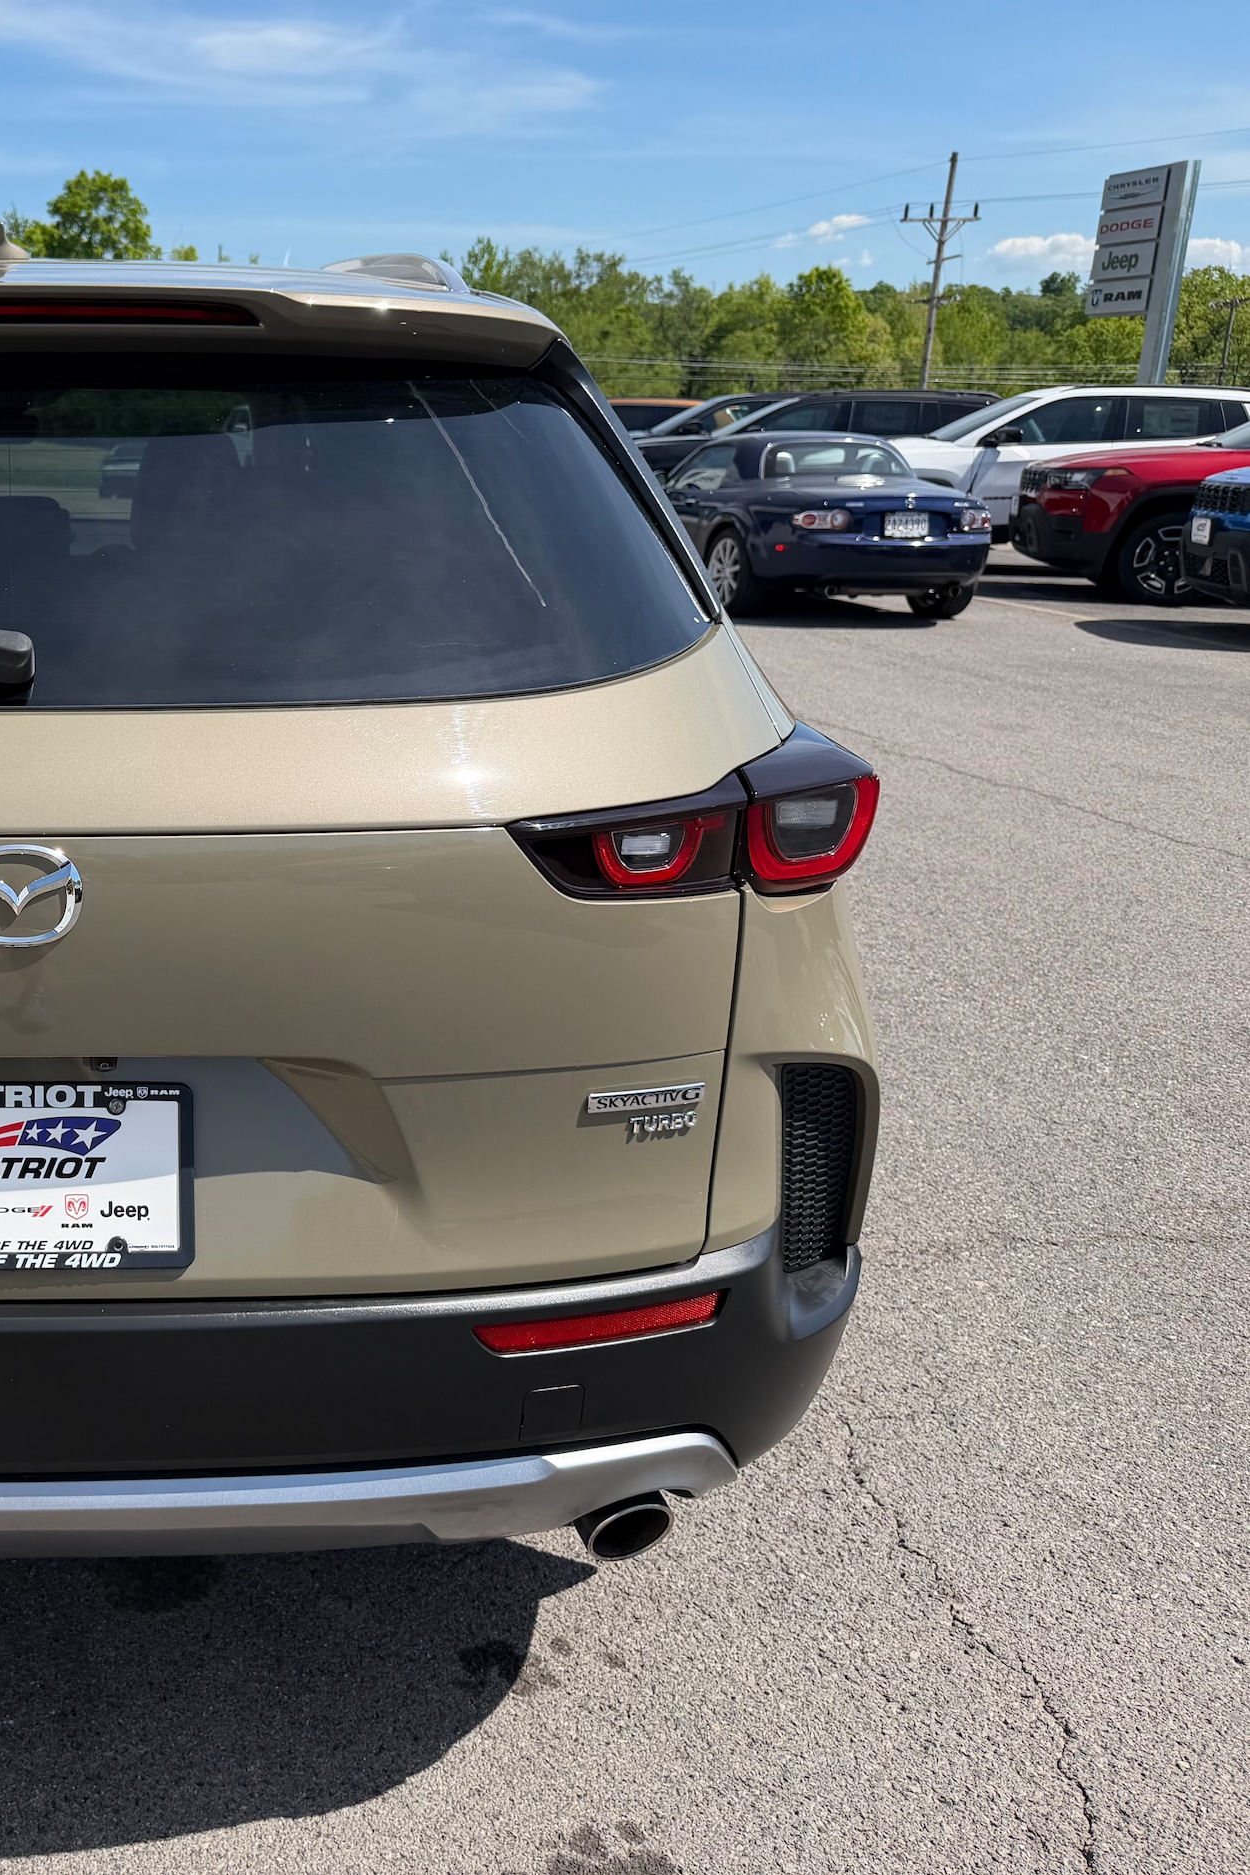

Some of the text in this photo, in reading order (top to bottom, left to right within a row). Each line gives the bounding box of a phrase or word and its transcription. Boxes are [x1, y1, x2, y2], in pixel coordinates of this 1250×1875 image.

[1108, 176, 1159, 191] CHRYSLER
[1099, 217, 1154, 234] DODGE
[1101, 251, 1139, 273] Jeep
[1103, 290, 1142, 303] RAM
[104, 1086, 134, 1099] Jeep
[630, 1110, 698, 1134] TURBO
[100, 1201, 150, 1221] Jeep
[20, 1240, 49, 1251] THE
[53, 1240, 94, 1251] 4WD
[15, 1253, 57, 1269] THE
[65, 1253, 122, 1269] 4WD
